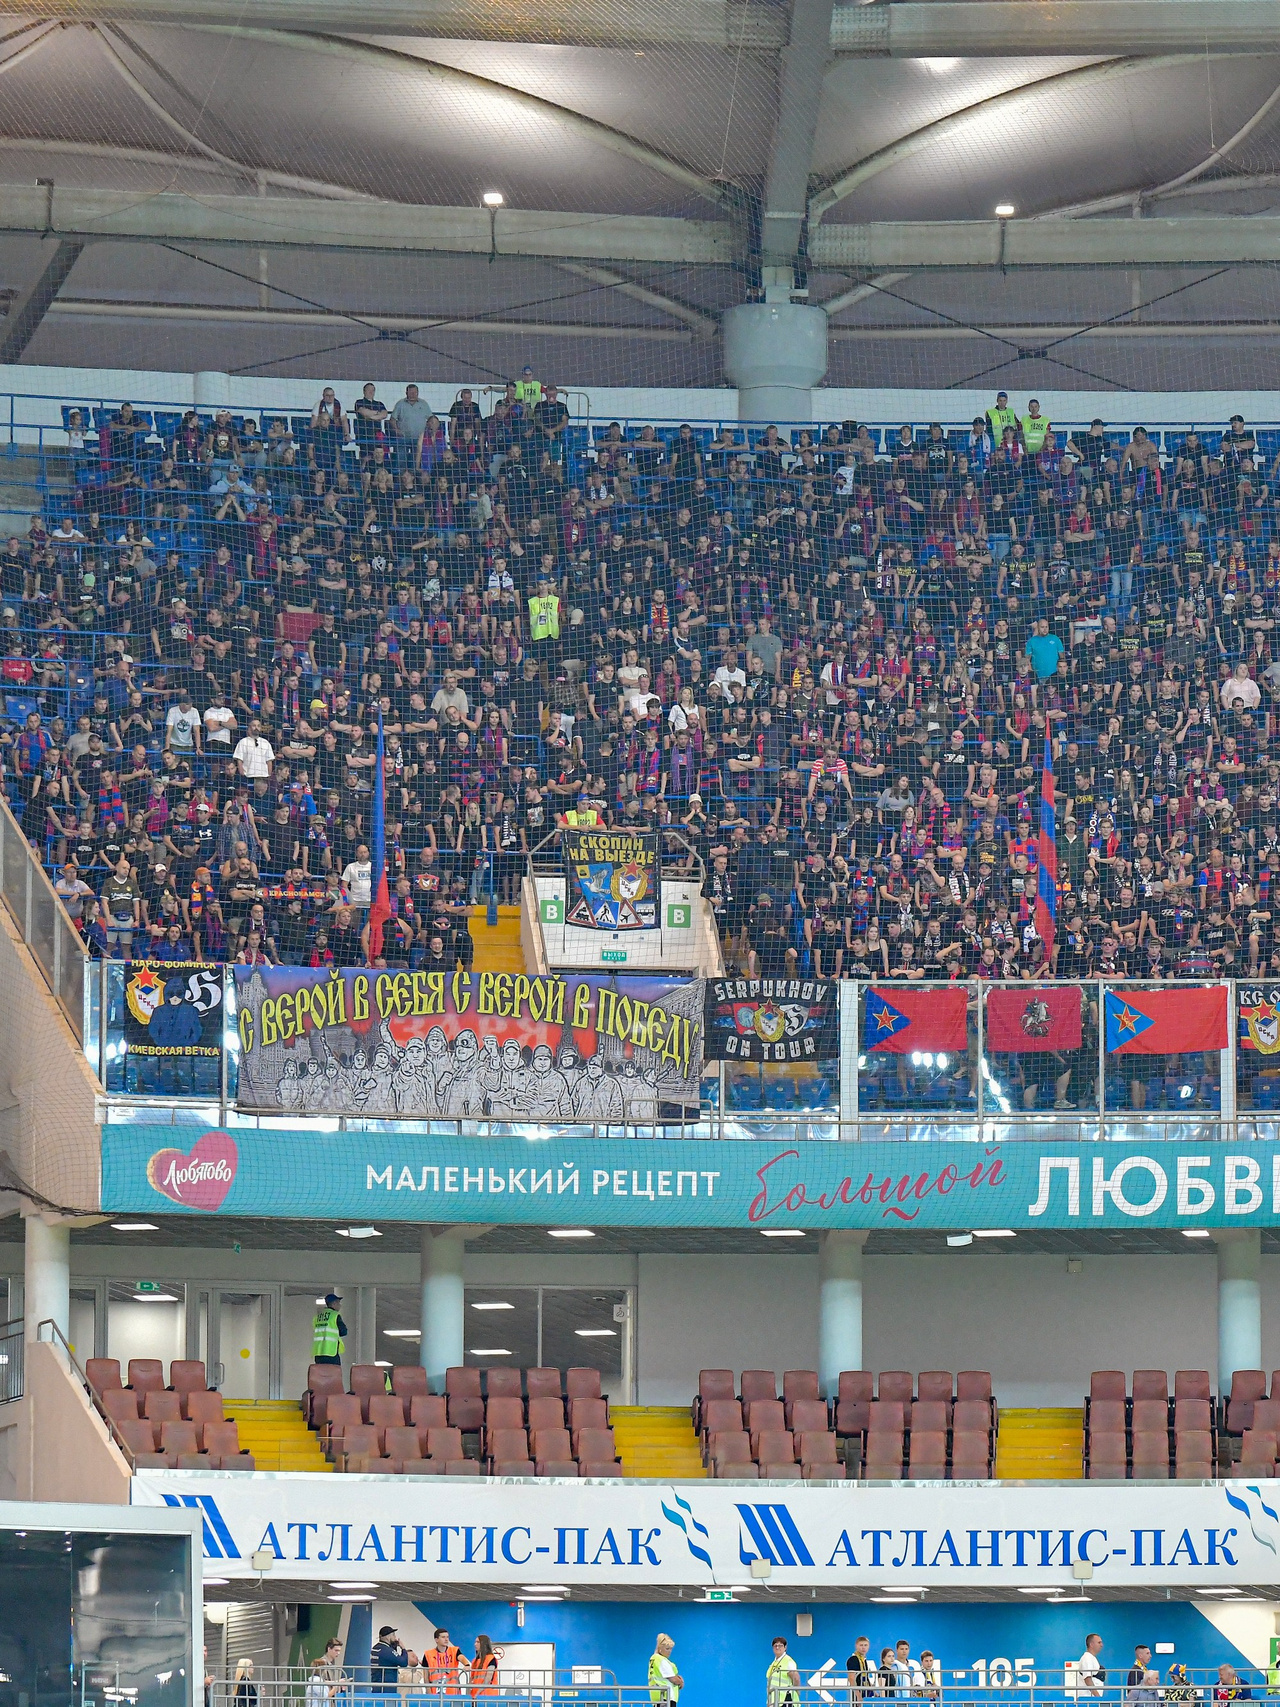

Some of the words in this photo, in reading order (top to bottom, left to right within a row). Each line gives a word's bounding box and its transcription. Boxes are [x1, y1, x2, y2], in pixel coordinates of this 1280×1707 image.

[580, 836, 644, 851] СКОПИН
[569, 848, 590, 861] НА
[595, 849, 655, 865] ВЫЕЗДЕ
[268, 889, 326, 898] КРАСНОКАМСК
[131, 960, 217, 970] НАРО-ФОМИНСК
[714, 980, 828, 1002] SERPUKHOV
[1239, 990, 1264, 1005] КС
[138, 994, 155, 1010] ЦСКА
[239, 1007, 254, 1053] С
[261, 969, 347, 1047] ВЕРОЙ
[353, 976, 369, 1021] В
[375, 971, 446, 1019] СЕБЯ
[452, 971, 471, 1014] С
[479, 972, 568, 1026] ВЕРОЙ
[571, 983, 590, 1029] В
[595, 987, 700, 1079] ПОБЕДУ
[128, 1044, 182, 1056] КИЕВСКАЯ
[185, 1046, 220, 1056] ВЕТКА
[725, 1035, 751, 1057] ON
[762, 1036, 816, 1060] TOUR
[164, 1157, 232, 1198] Любятово
[366, 1161, 580, 1194] МАЛЕНЬКИЙ
[593, 1170, 721, 1201] РЕЦЕПТ
[748, 1146, 1007, 1221] большой
[257, 1521, 663, 1567] АТЛАНТИС-ПАК
[825, 1528, 1238, 1567] АТЛАНТИС-ПАК
